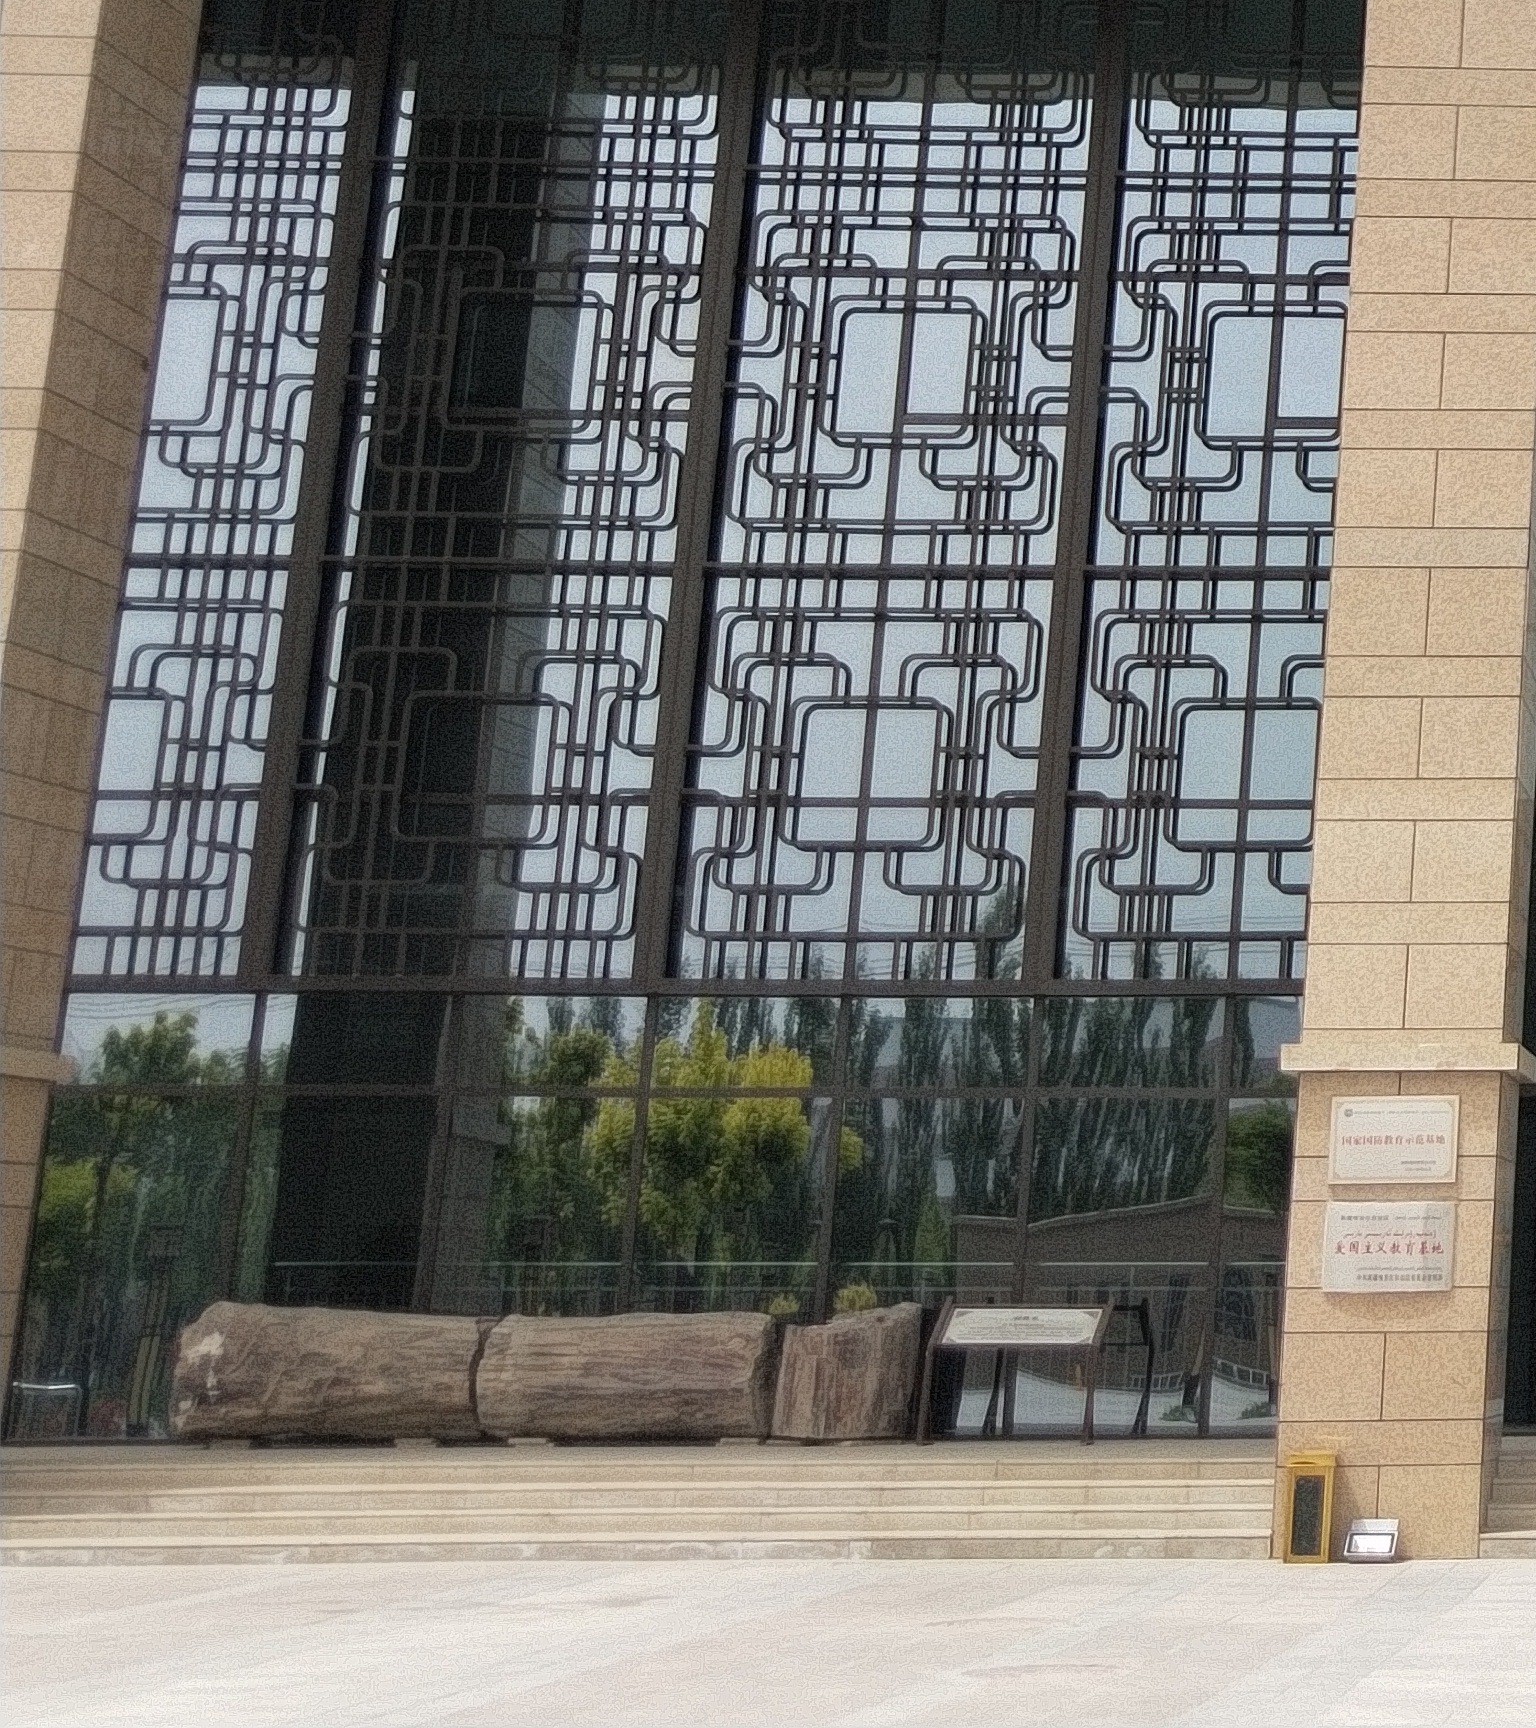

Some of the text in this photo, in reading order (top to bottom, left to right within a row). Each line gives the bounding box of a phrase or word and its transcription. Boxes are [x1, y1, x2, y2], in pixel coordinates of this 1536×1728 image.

[1335, 1241, 1444, 1255] 爱国主义教育基地
